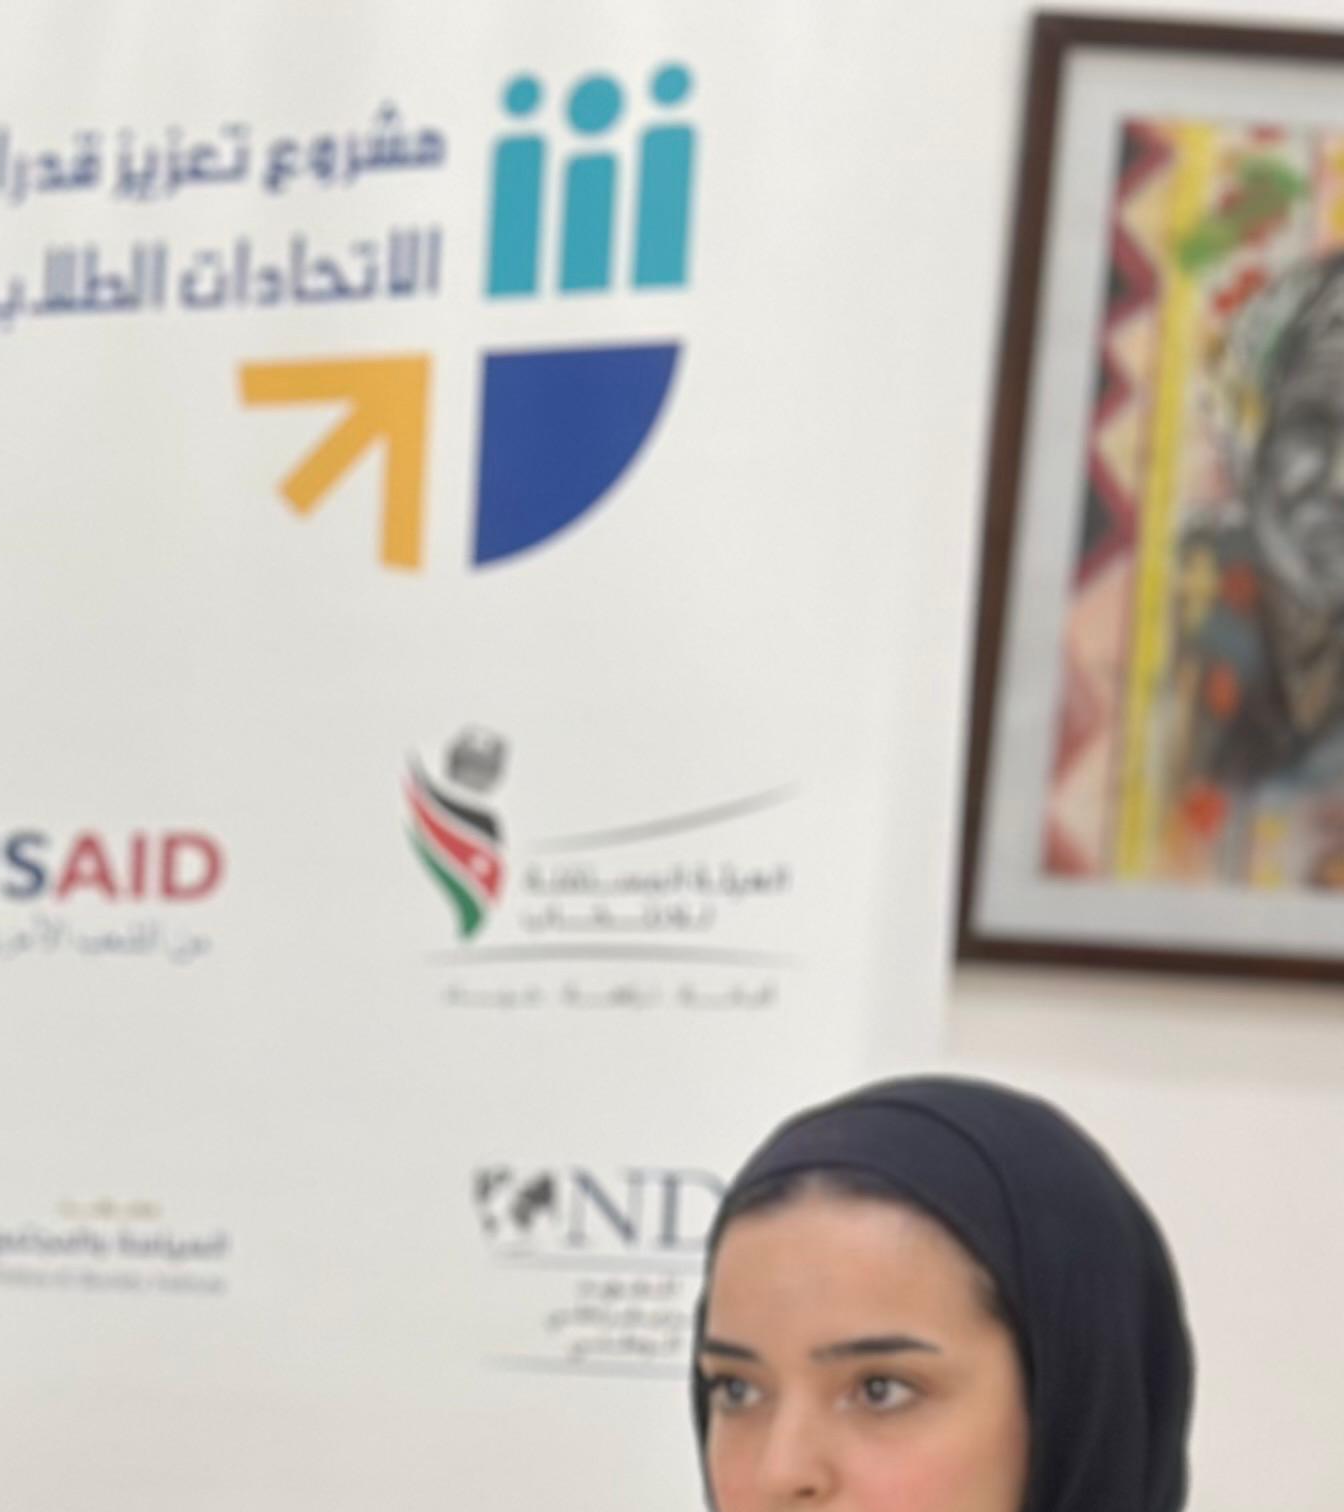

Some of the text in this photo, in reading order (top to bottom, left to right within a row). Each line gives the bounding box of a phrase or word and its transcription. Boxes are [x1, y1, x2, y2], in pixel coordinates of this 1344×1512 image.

[112, 122, 252, 201] تعزيز
[263, 100, 447, 195] مشروع
[178, 222, 443, 309] الاتحادات
